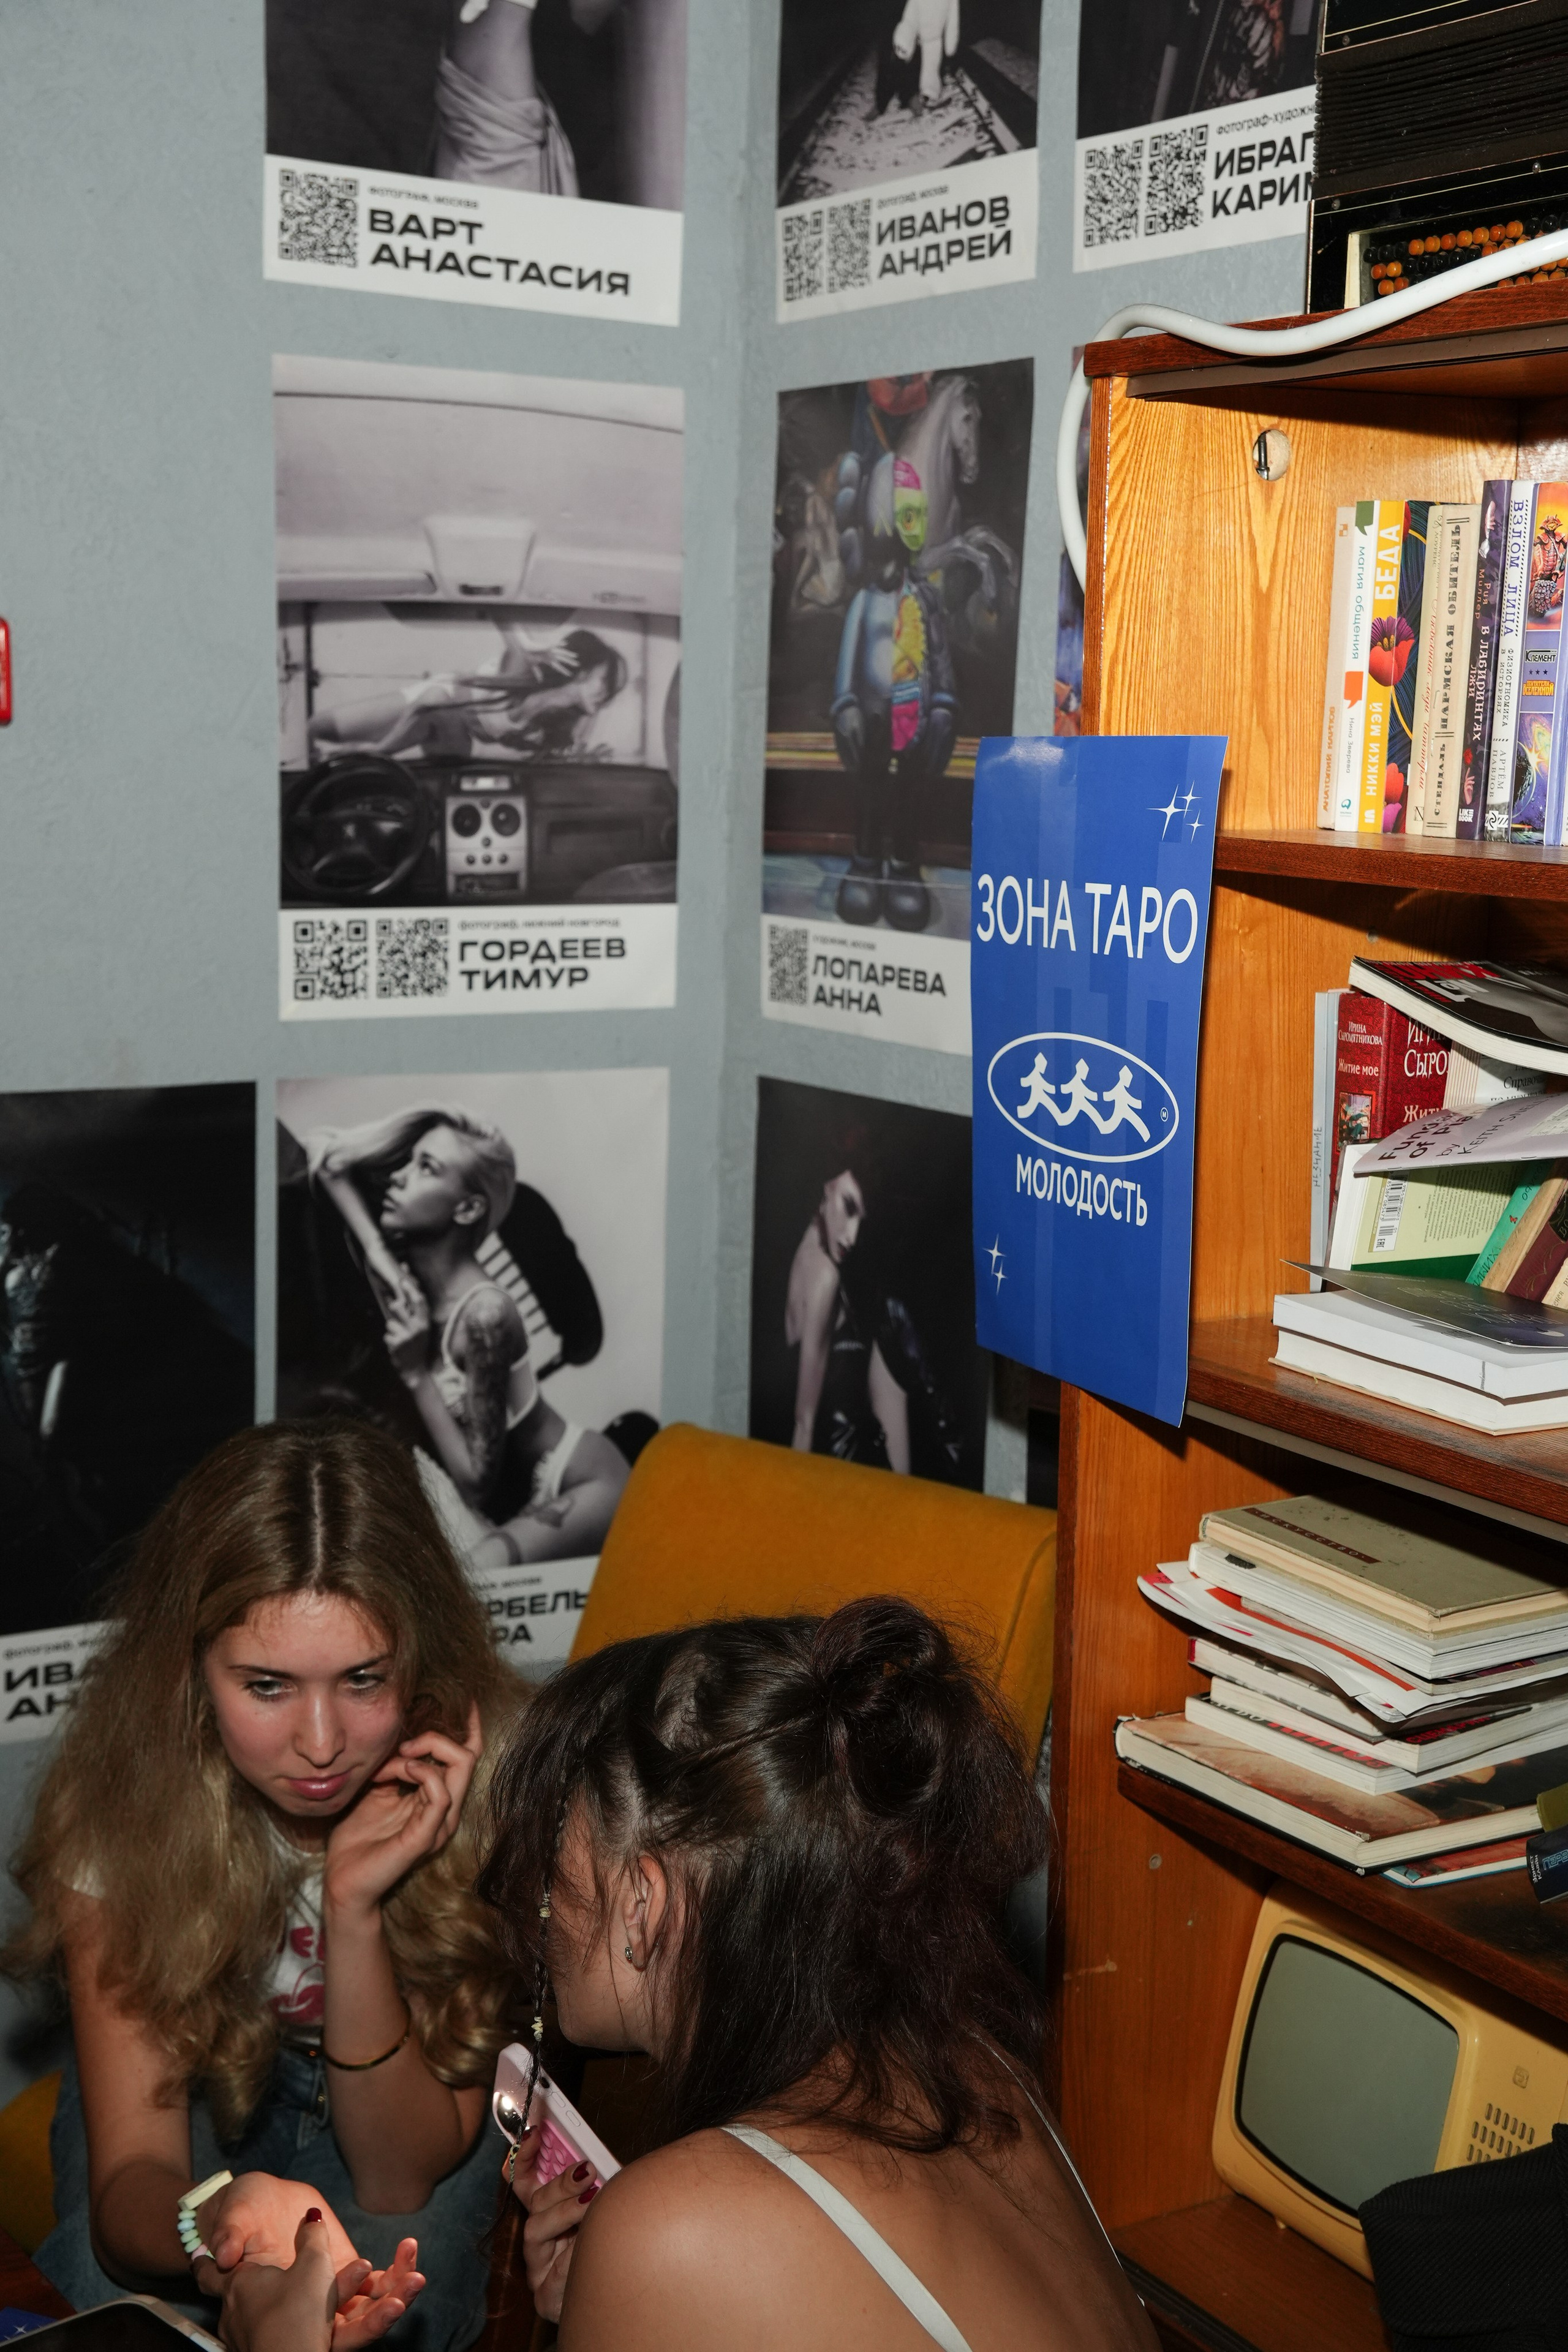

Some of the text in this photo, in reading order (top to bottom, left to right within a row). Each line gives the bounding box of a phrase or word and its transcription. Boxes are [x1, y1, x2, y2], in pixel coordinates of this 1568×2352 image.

[369, 208, 483, 246] ВАРТ
[876, 195, 1011, 246] ИВАНОВ
[371, 244, 630, 296] АНАСТАСИЯ
[878, 223, 1012, 279] АНДРЕЙ
[1374, 524, 1401, 600] БЕДА
[1501, 499, 1525, 636] ВЗЛОМ ЛИЦА
[1352, 546, 1365, 660] магия общения
[1441, 525, 1461, 729] ПАРМСКАЯ ОБИТЕЛЬ
[1472, 639, 1489, 741] ЛАБИРИНТАХ
[1502, 648, 1513, 727] ФИЗИОГНОМИКА
[1369, 702, 1384, 736] МЭЙ
[1365, 742, 1381, 796] НИККИ
[1434, 743, 1446, 816] СТЕНДАЛЬ
[1489, 750, 1498, 797] ПАВЛОВ
[1497, 750, 1507, 790] АРТЁМ
[976, 873, 1198, 963] ЗОНА ТАРО
[459, 938, 625, 964] ГОРДЕЕВ
[459, 967, 589, 990] ТИМУР
[812, 954, 947, 997] ЛОПАРЕВА
[813, 984, 882, 1016] АННА
[1348, 1021, 1367, 1034] ИРИНА
[1338, 1058, 1379, 1077] Житие мое
[1404, 1049, 1450, 1079] СЫРО
[1457, 1125, 1504, 1155] KEITH
[1016, 1153, 1148, 1227] МОЛОДОСТЬ
[488, 1589, 589, 1618] РБЕЛЬ
[492, 1623, 532, 1645] РА
[5, 1662, 74, 1692] ИВ
[6, 1692, 78, 1722] АН
